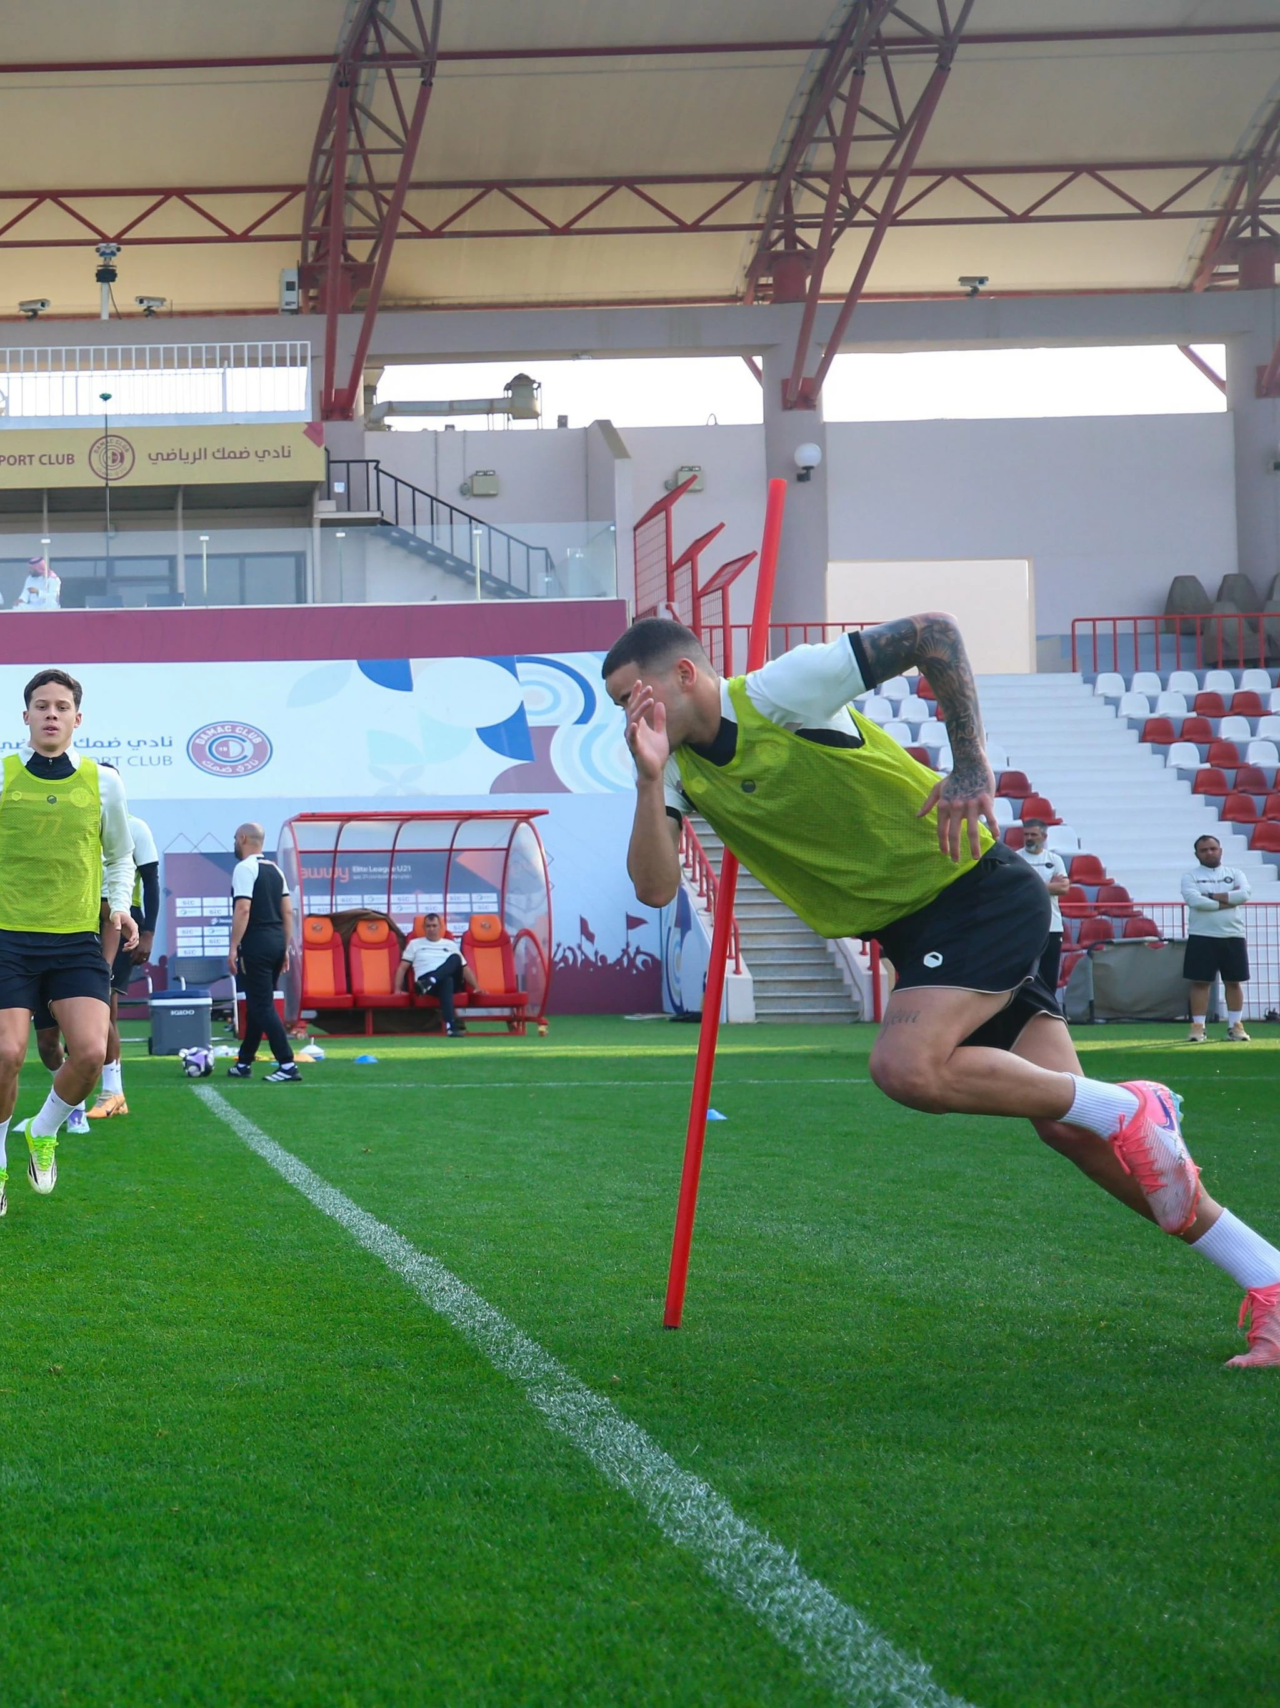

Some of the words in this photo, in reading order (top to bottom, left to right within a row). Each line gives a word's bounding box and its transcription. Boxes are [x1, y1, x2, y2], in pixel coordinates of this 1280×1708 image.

[38, 453, 75, 466] CLUB
[148, 447, 207, 465] الرياضي
[212, 446, 251, 460] ضمك
[254, 445, 292, 463] نادي
[194, 725, 232, 745] DAMAC
[235, 726, 263, 744] CLUB
[73, 737, 121, 749] ضمك
[127, 735, 173, 751] نادي
[127, 755, 173, 767] CLUB
